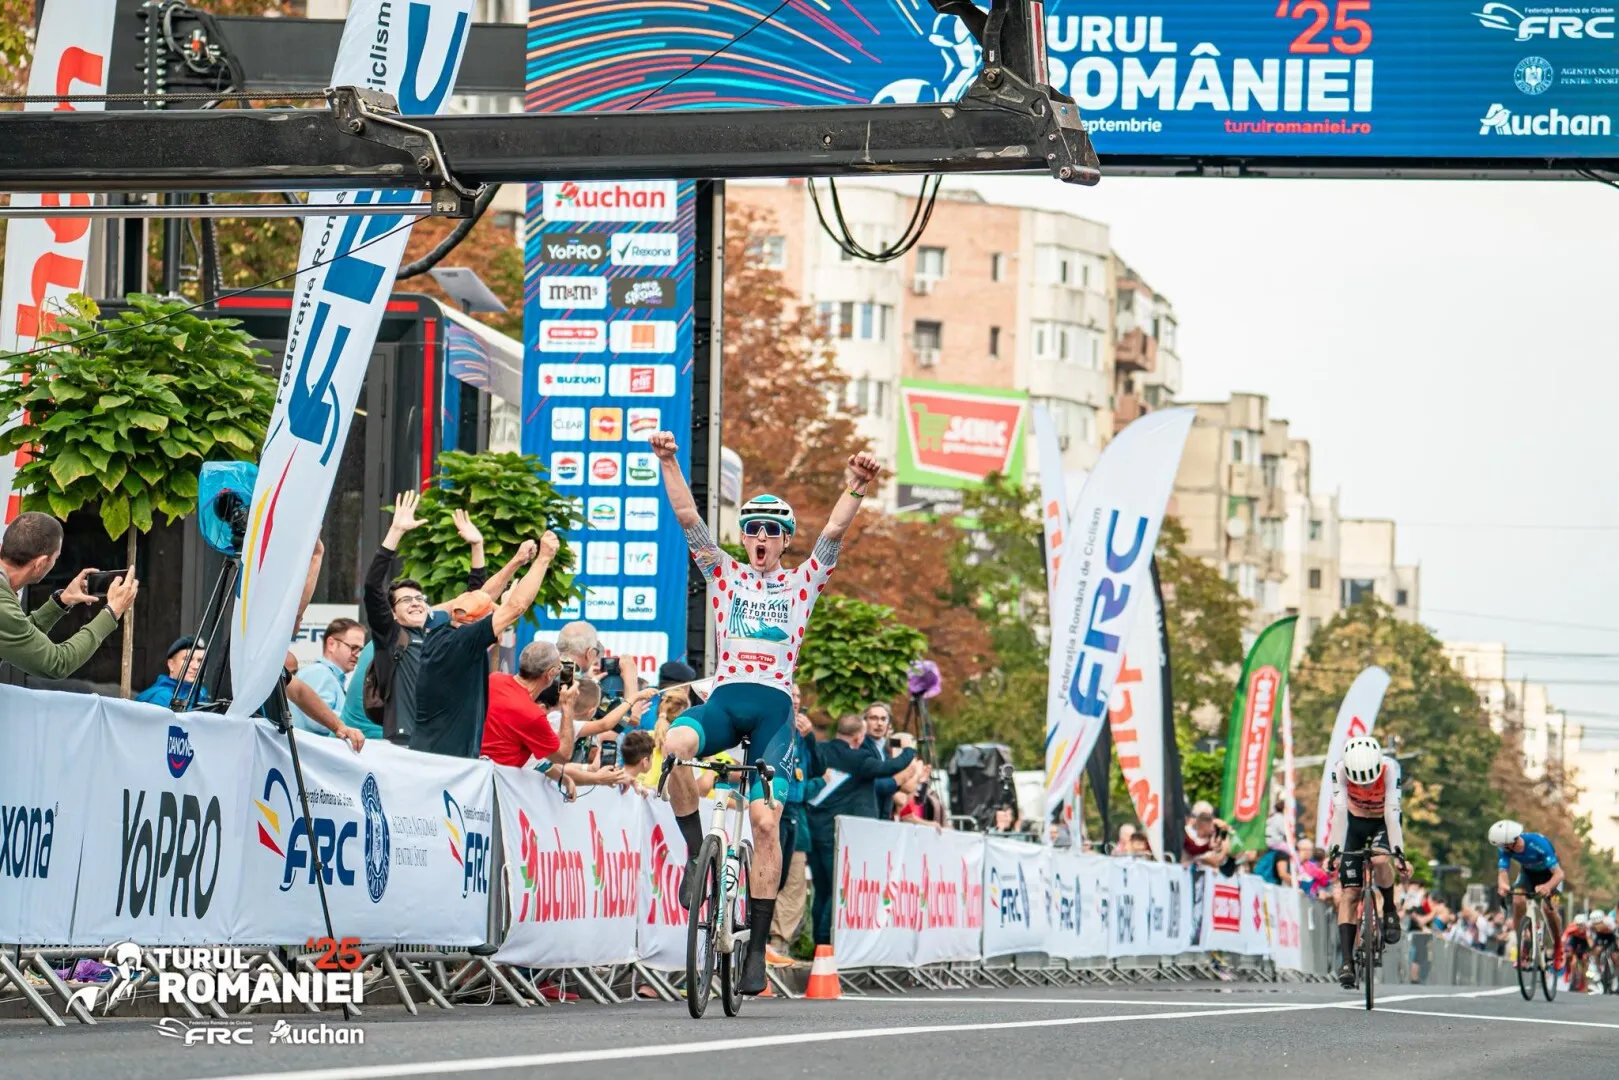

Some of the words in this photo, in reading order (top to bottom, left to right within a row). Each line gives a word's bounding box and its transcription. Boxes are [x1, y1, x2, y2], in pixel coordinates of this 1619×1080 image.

[1046, 15, 1177, 52] URUL
[1517, 16, 1616, 40] FRC
[367, 2, 392, 93] iclism
[1082, 117, 1162, 133] eptembrie
[1224, 118, 1371, 134] turulromaniei.ro
[1479, 103, 1611, 136] Auchan
[555, 181, 666, 208] Auchan
[547, 244, 602, 260] YoPRO
[631, 246, 671, 257] Rexona
[556, 376, 601, 384] SUZUKI
[552, 418, 583, 430] CLEAR
[1085, 506, 1103, 557] Ciclism
[1080, 559, 1093, 578] de
[735, 597, 788, 612] BAHRAIN
[1068, 580, 1088, 635] Română
[1069, 509, 1149, 719] FRC
[292, 628, 328, 643] FR
[115, 788, 222, 920] YoPRO
[281, 816, 358, 891] FRC
[463, 831, 490, 898] FRC
[519, 808, 586, 923] Auchan
